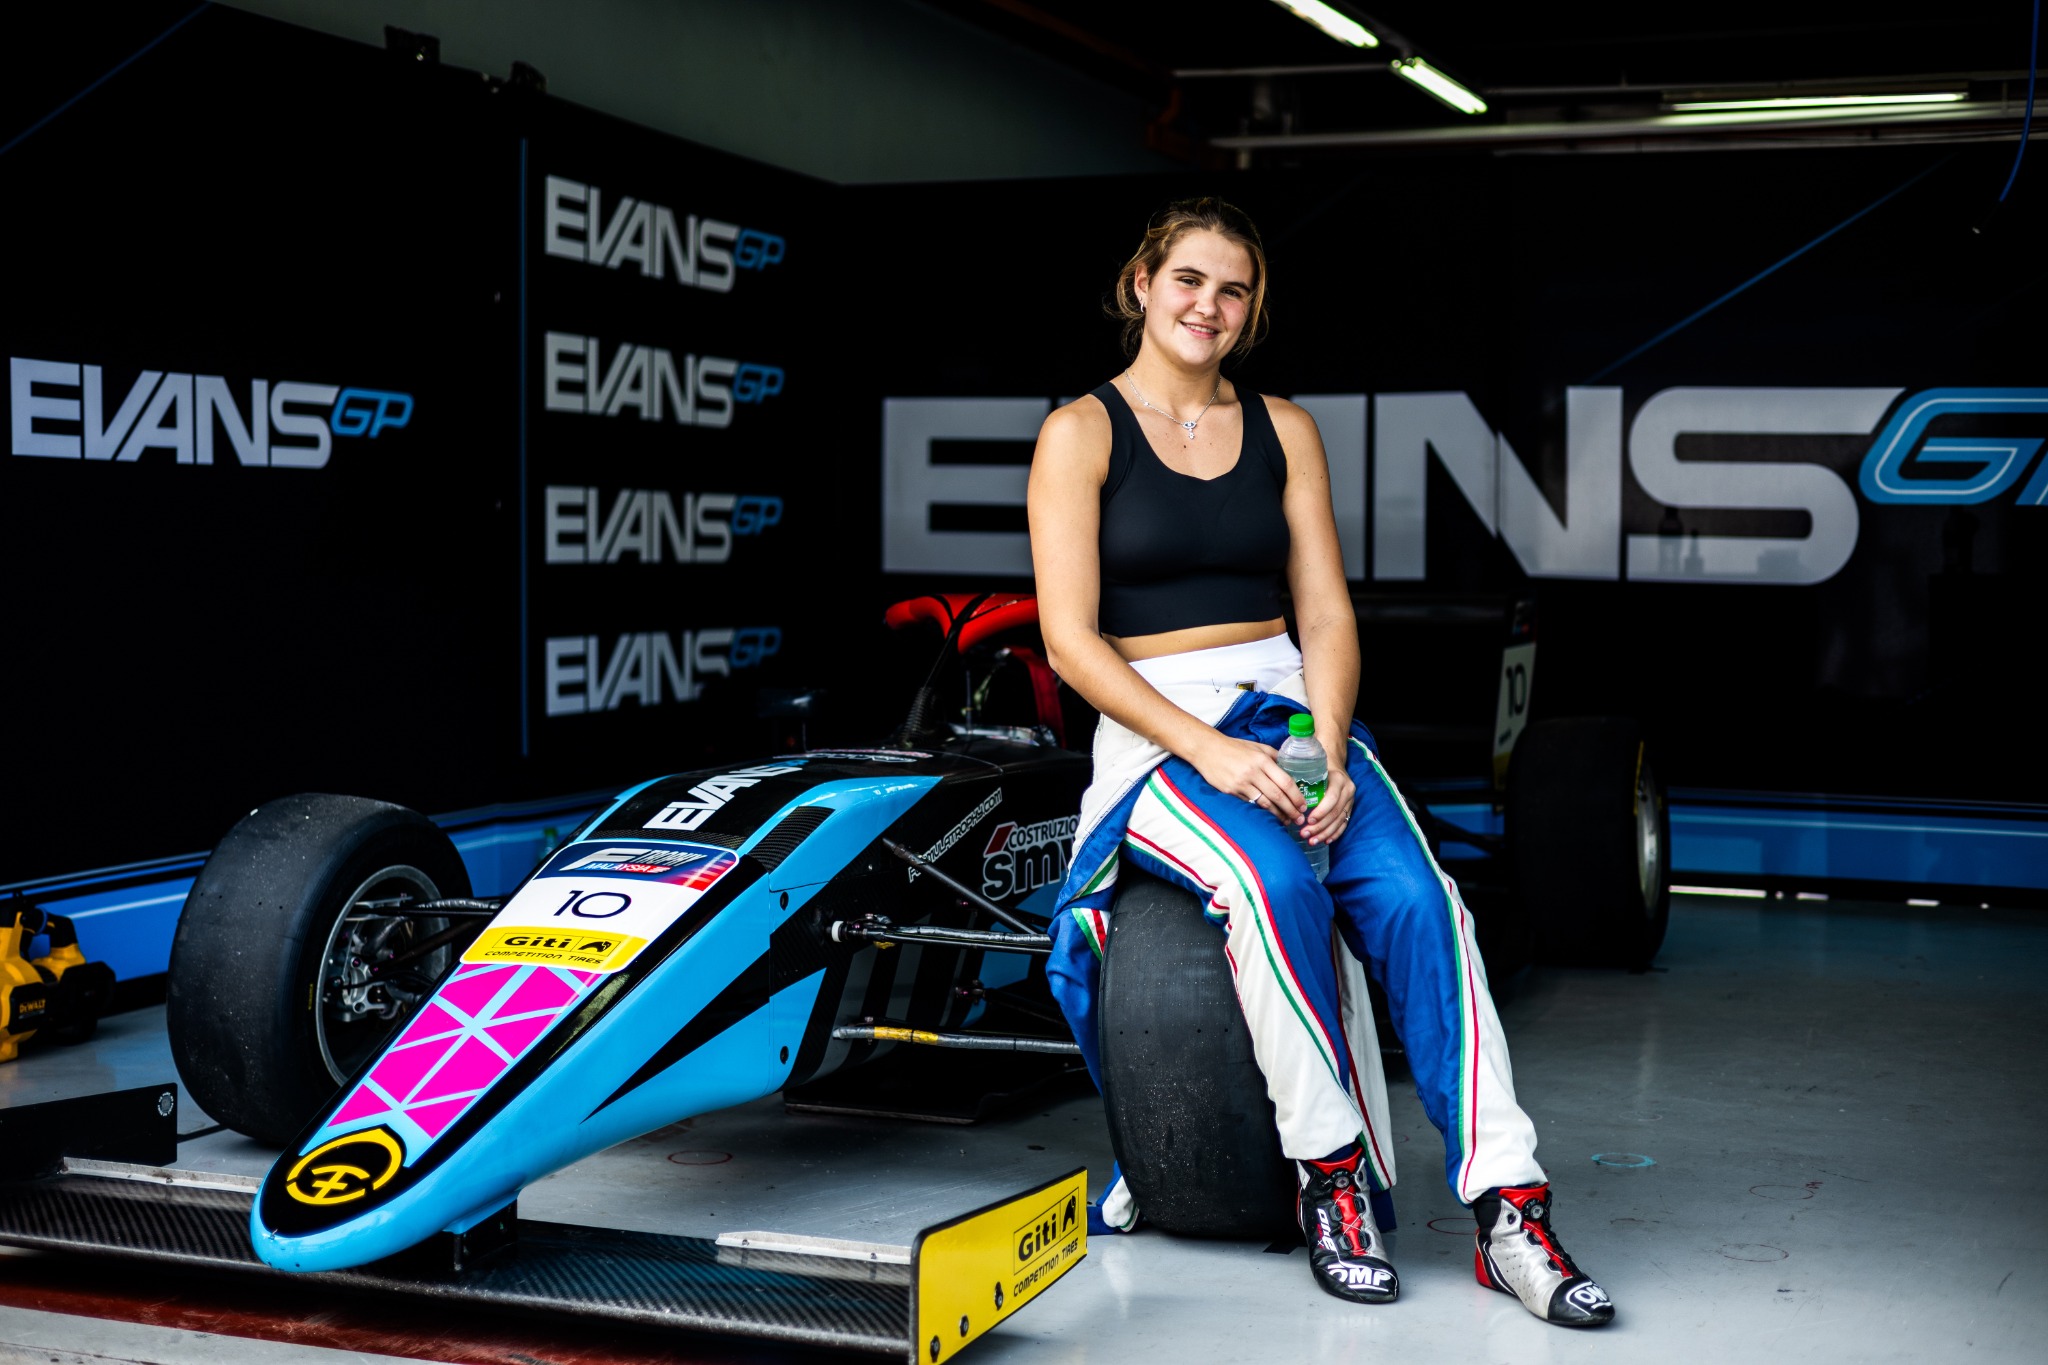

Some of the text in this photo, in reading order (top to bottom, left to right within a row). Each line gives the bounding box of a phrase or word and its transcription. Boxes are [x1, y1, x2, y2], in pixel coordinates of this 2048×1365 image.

[545, 174, 786, 293] EVANS GP
[545, 330, 785, 428] EVANS GP
[10, 357, 414, 468] EVANS GP
[883, 387, 2048, 585] ENS G
[545, 485, 784, 563] EVANS GP
[730, 627, 782, 668] GP
[1506, 663, 1527, 717] 10
[642, 765, 804, 831] EVANS
[908, 786, 1002, 883] FMULATROPHY.COM
[1007, 815, 1080, 851] COSTRUZIO
[584, 862, 651, 874] MALAYSIA
[553, 890, 632, 919] 10
[485, 950, 603, 965] COMPETITION TIRES
[504, 936, 573, 949] Giti
[1018, 1213, 1056, 1262] Giti
[1013, 1237, 1079, 1297] COMPETITION TIRES
[1328, 1267, 1392, 1287] OMP
[1574, 1285, 1608, 1304] OM
